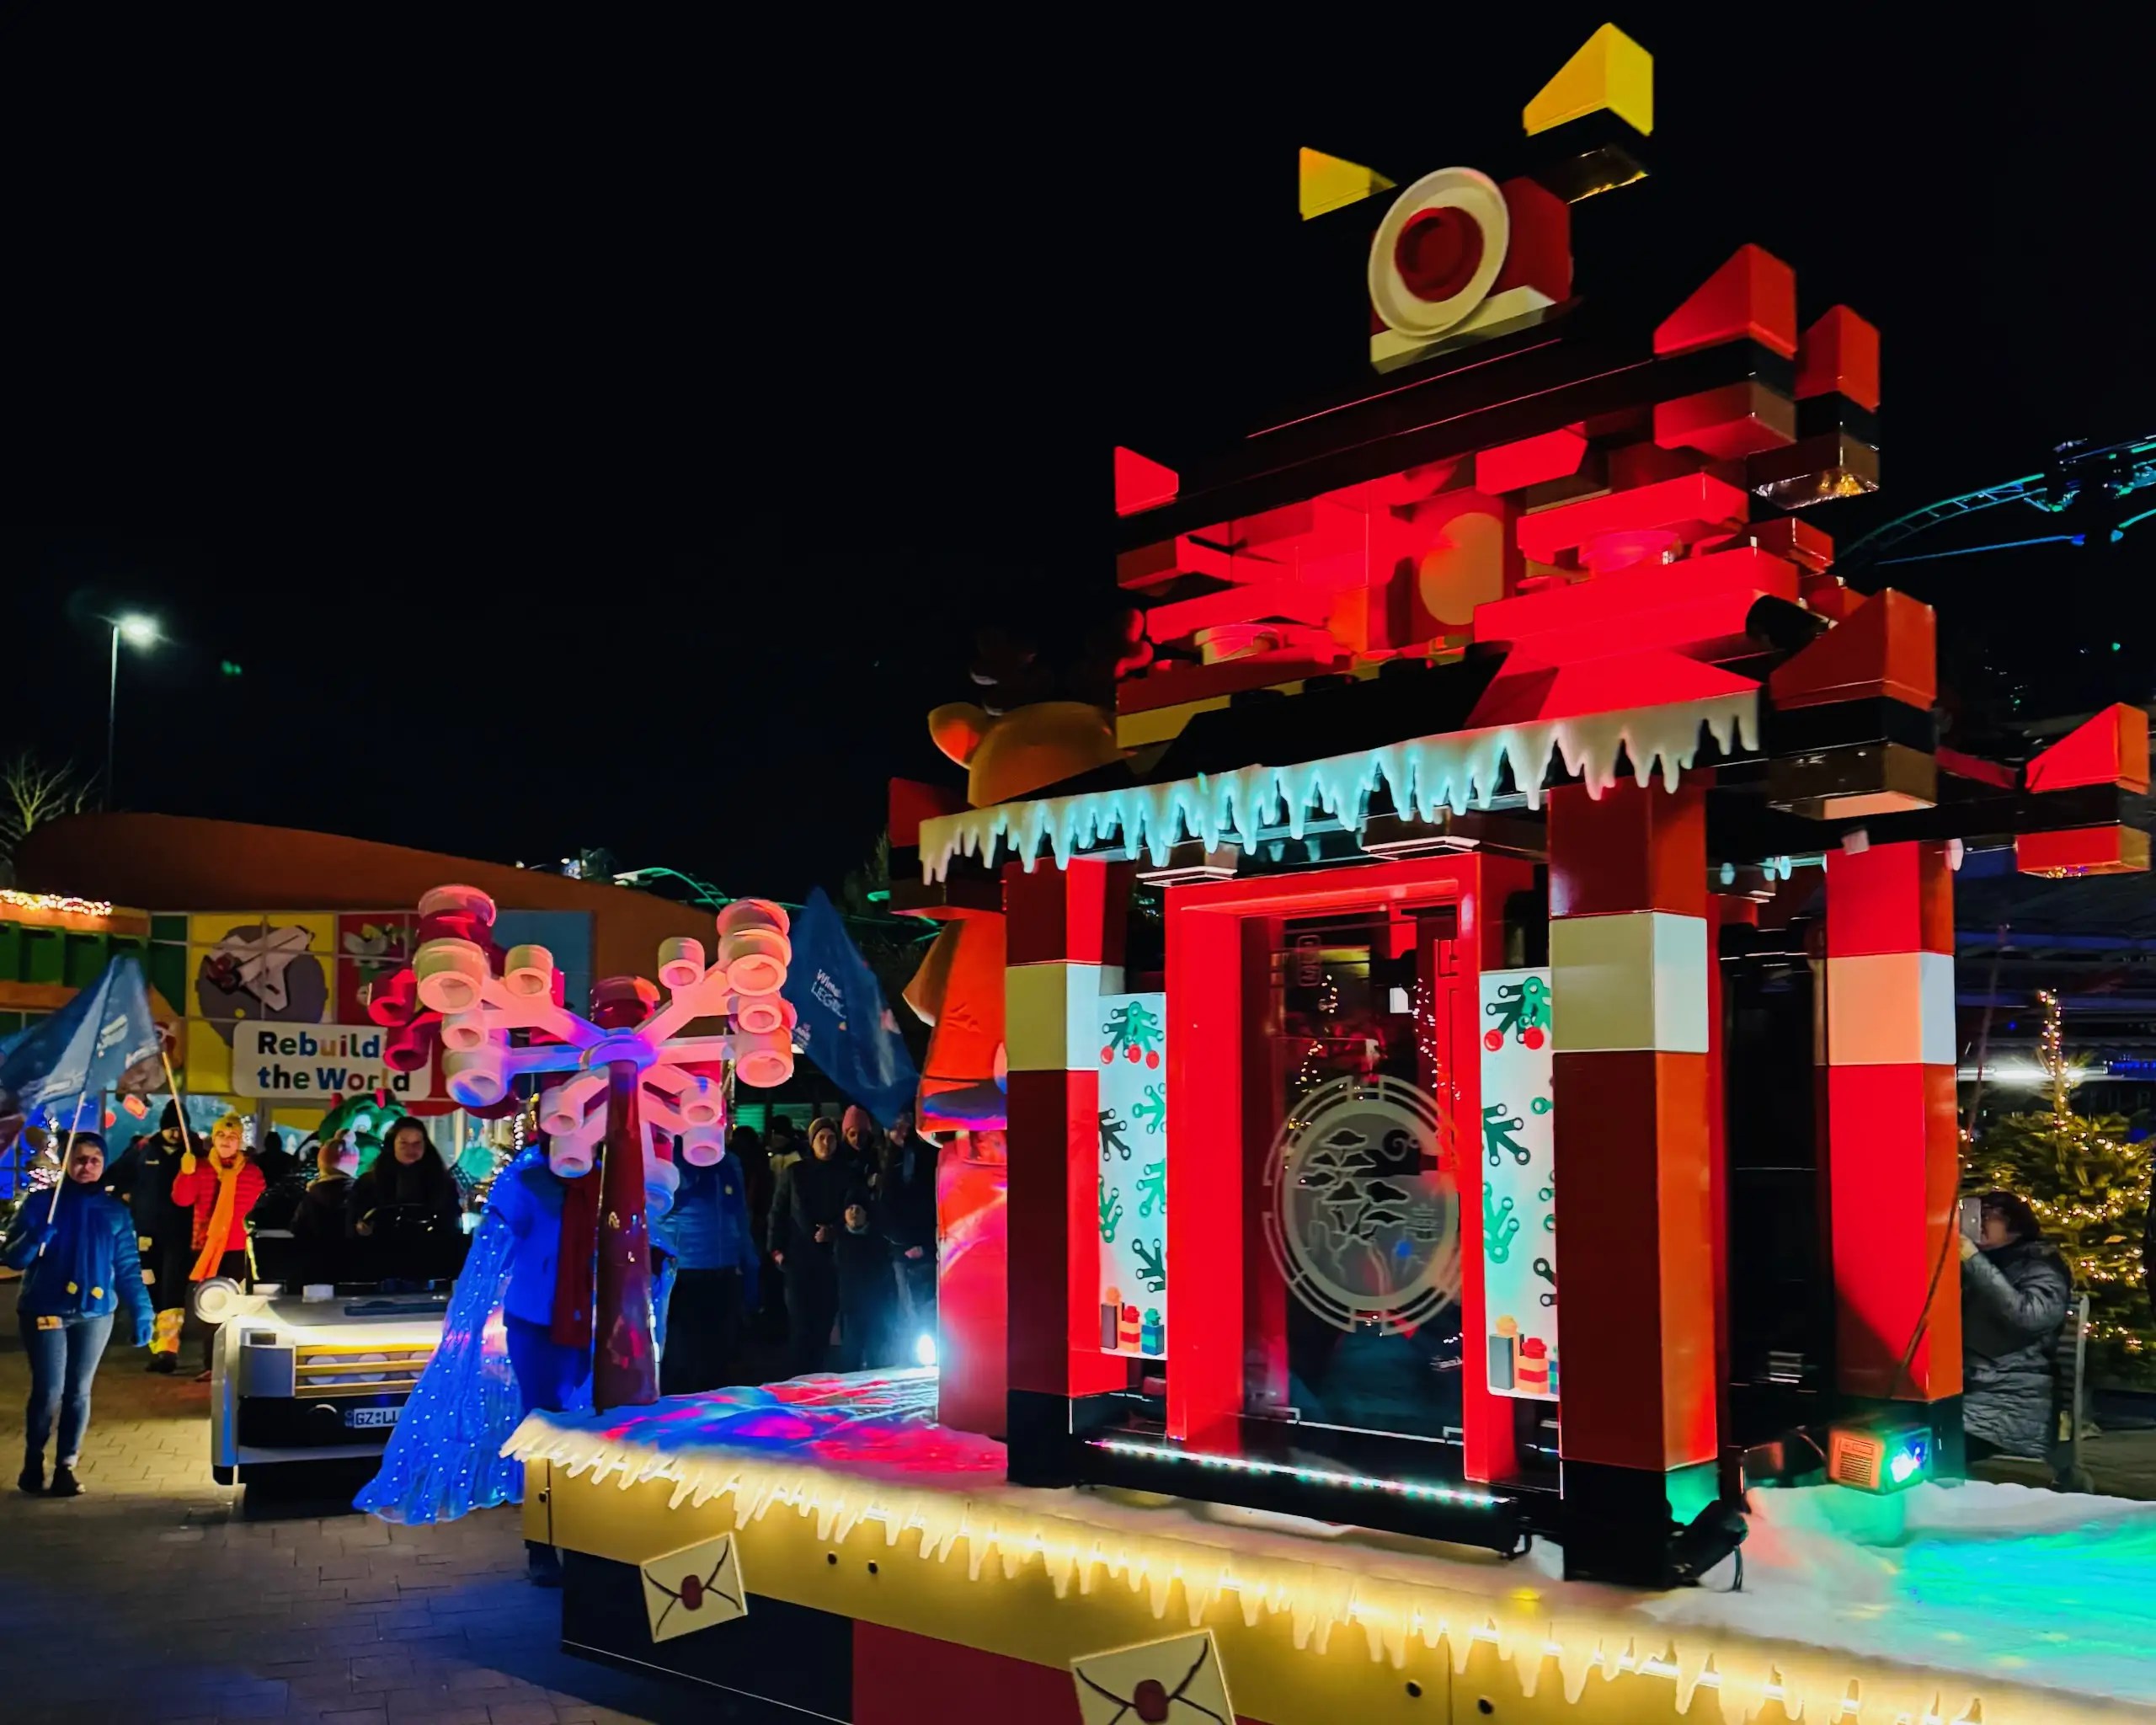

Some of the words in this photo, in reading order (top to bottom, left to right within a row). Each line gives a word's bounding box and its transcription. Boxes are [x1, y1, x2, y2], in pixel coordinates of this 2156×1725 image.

[258, 1031, 380, 1058] Rebuild
[257, 1064, 310, 1090] the
[316, 1065, 410, 1092] World
[355, 1412, 374, 1425] GZ
